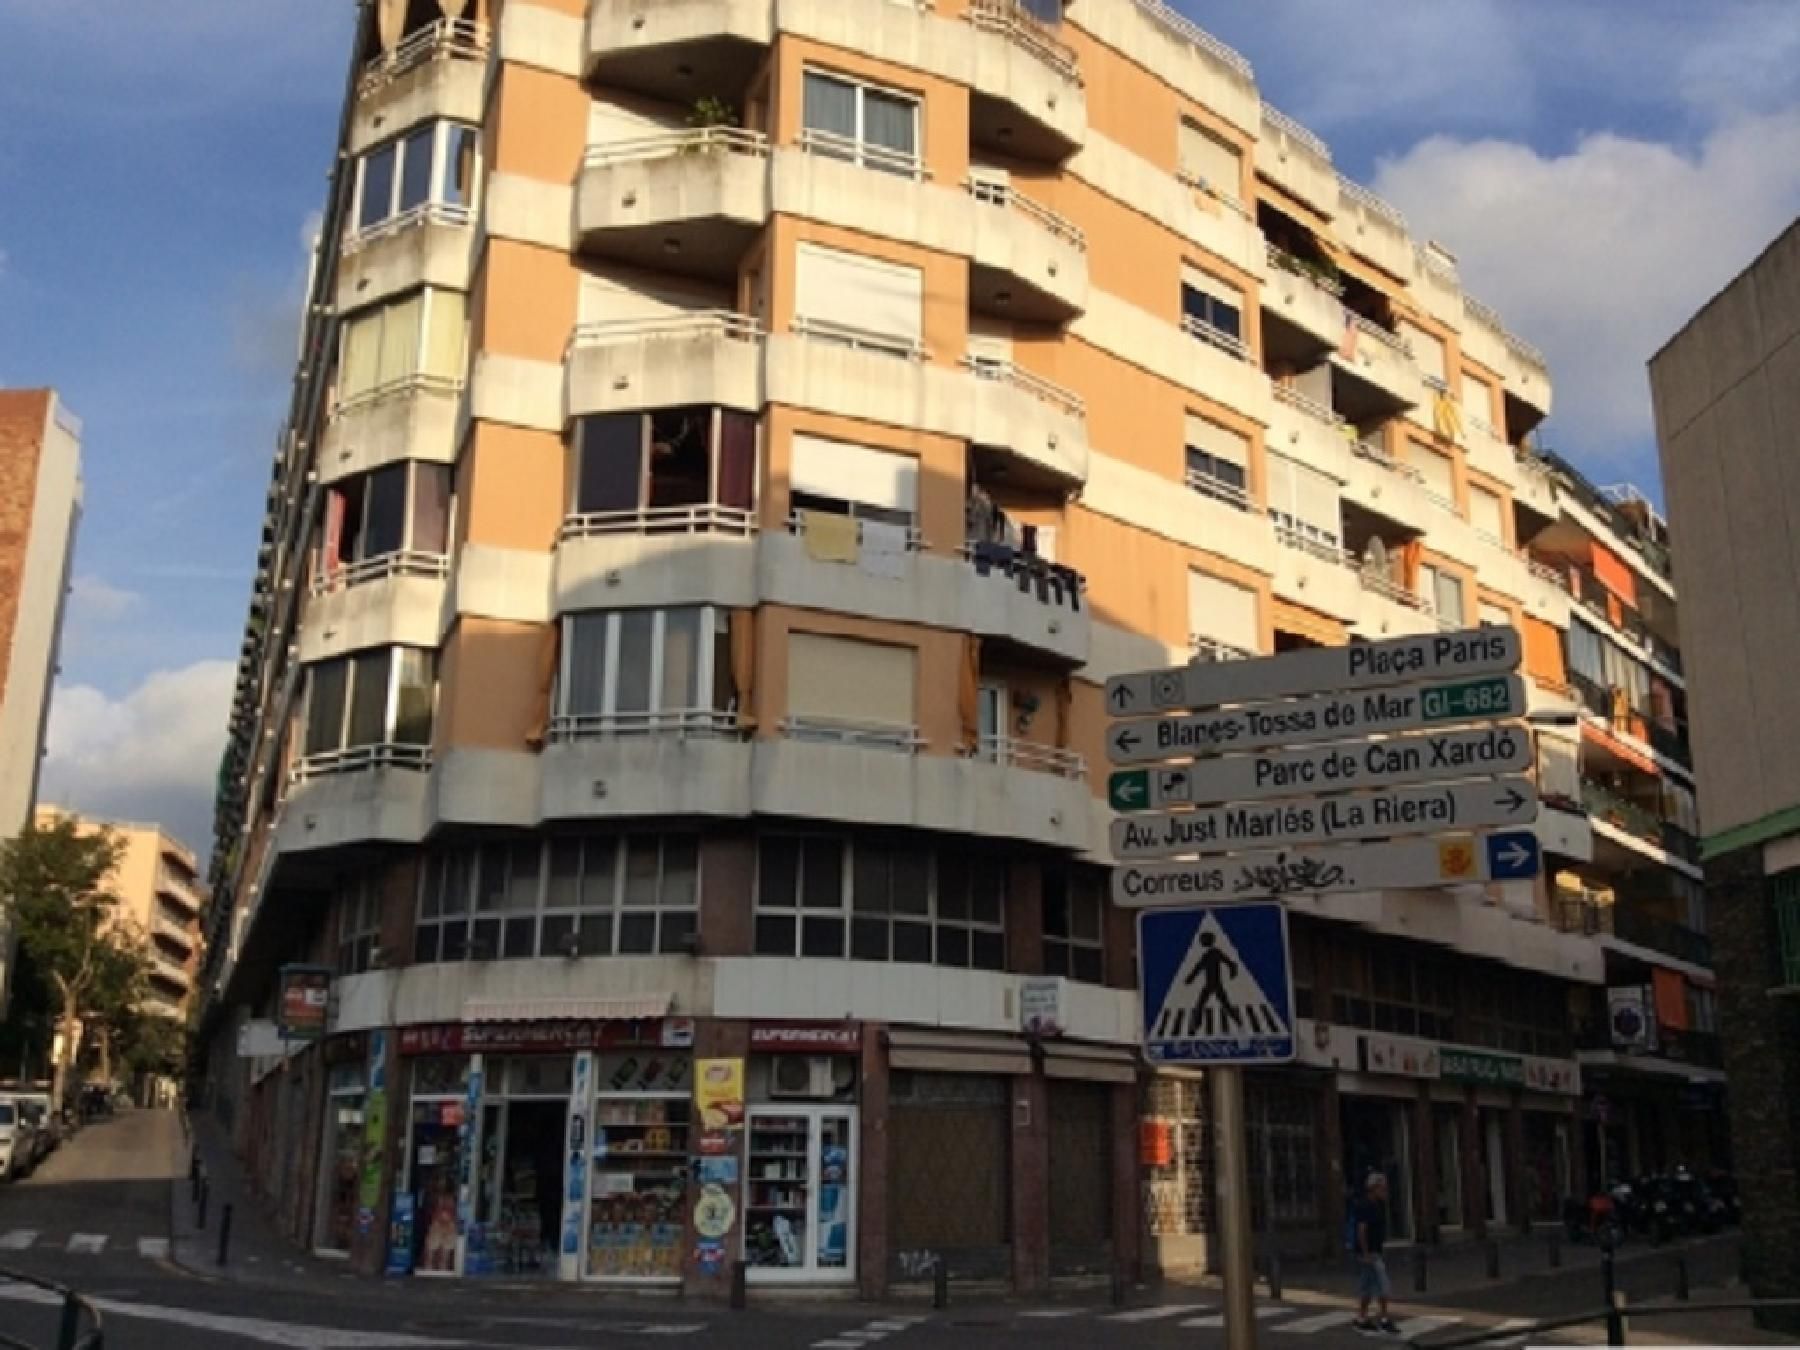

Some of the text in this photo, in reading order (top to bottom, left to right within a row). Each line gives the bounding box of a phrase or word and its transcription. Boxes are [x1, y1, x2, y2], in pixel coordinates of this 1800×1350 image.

[1349, 635, 1506, 676] Plaça Paris
[1324, 701, 1355, 728] de
[1364, 694, 1415, 721] Mar
[1256, 730, 1515, 787] Parc de Can Xardó
[1123, 791, 1456, 849] Av. Just Marlés (La Riera)
[1122, 868, 1224, 898] Correus
